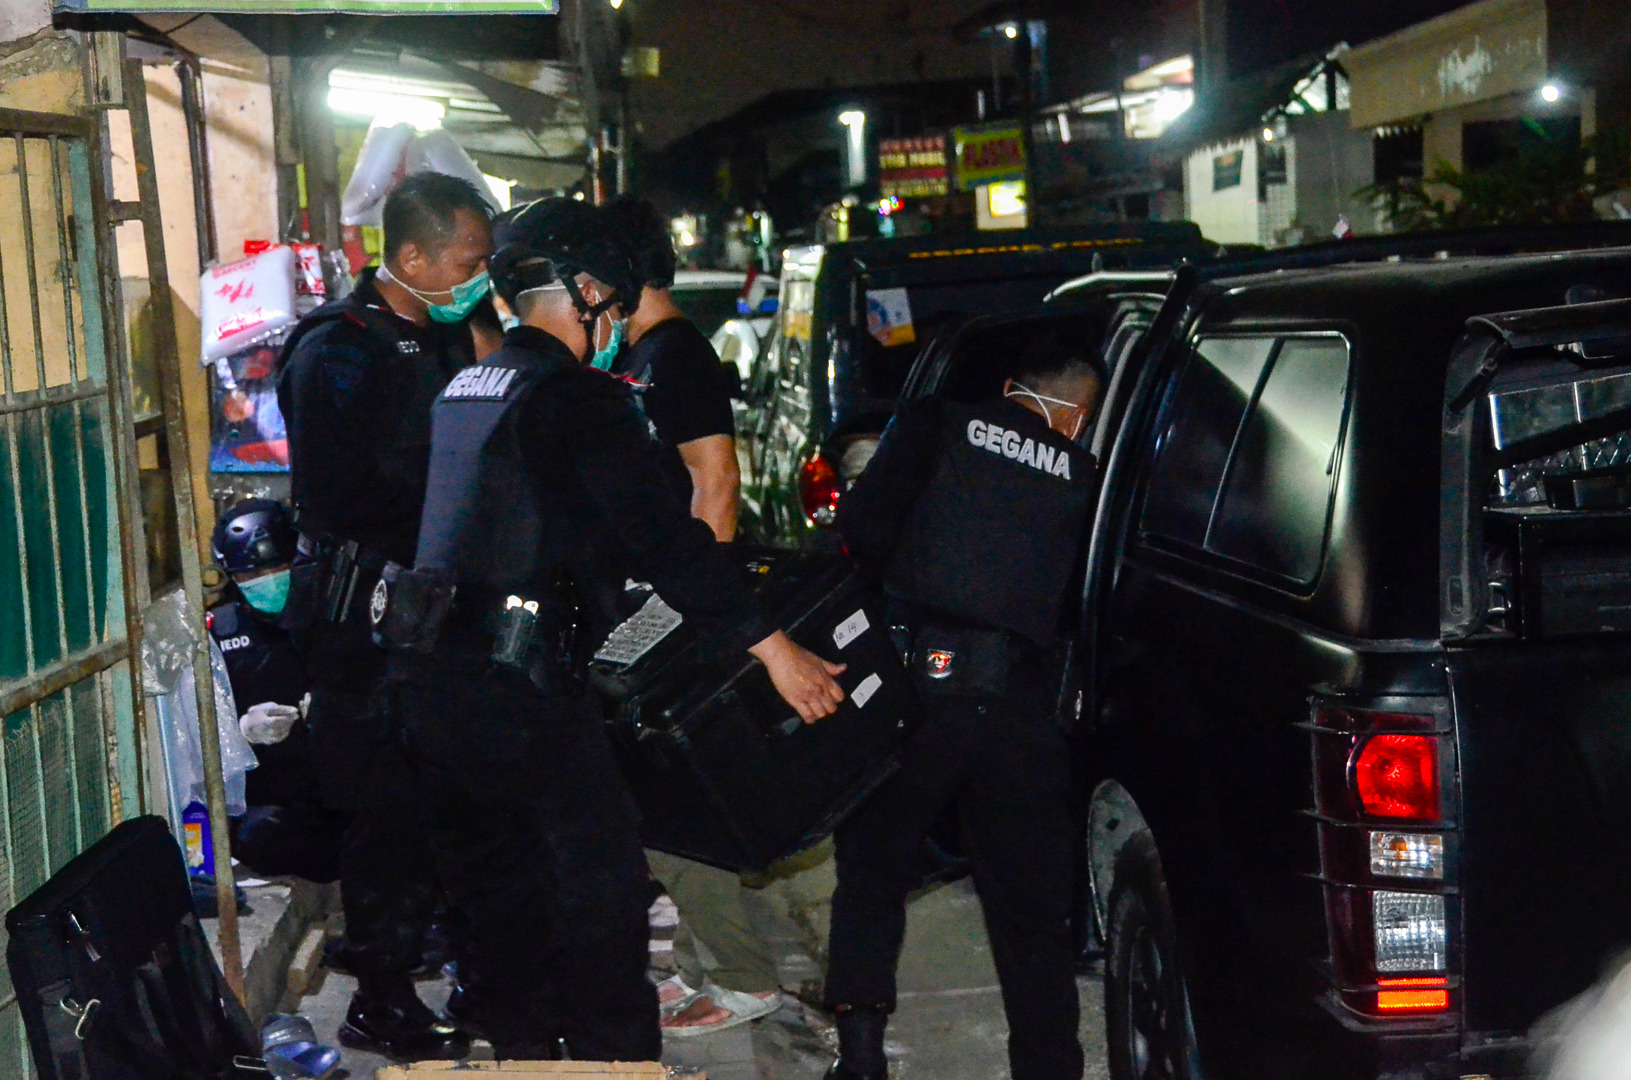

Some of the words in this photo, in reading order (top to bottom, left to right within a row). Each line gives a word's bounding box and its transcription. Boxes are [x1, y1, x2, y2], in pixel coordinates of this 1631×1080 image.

[443, 365, 517, 397] GEGANA
[966, 419, 1071, 480] GEGANA
[220, 635, 250, 652] IEDD
